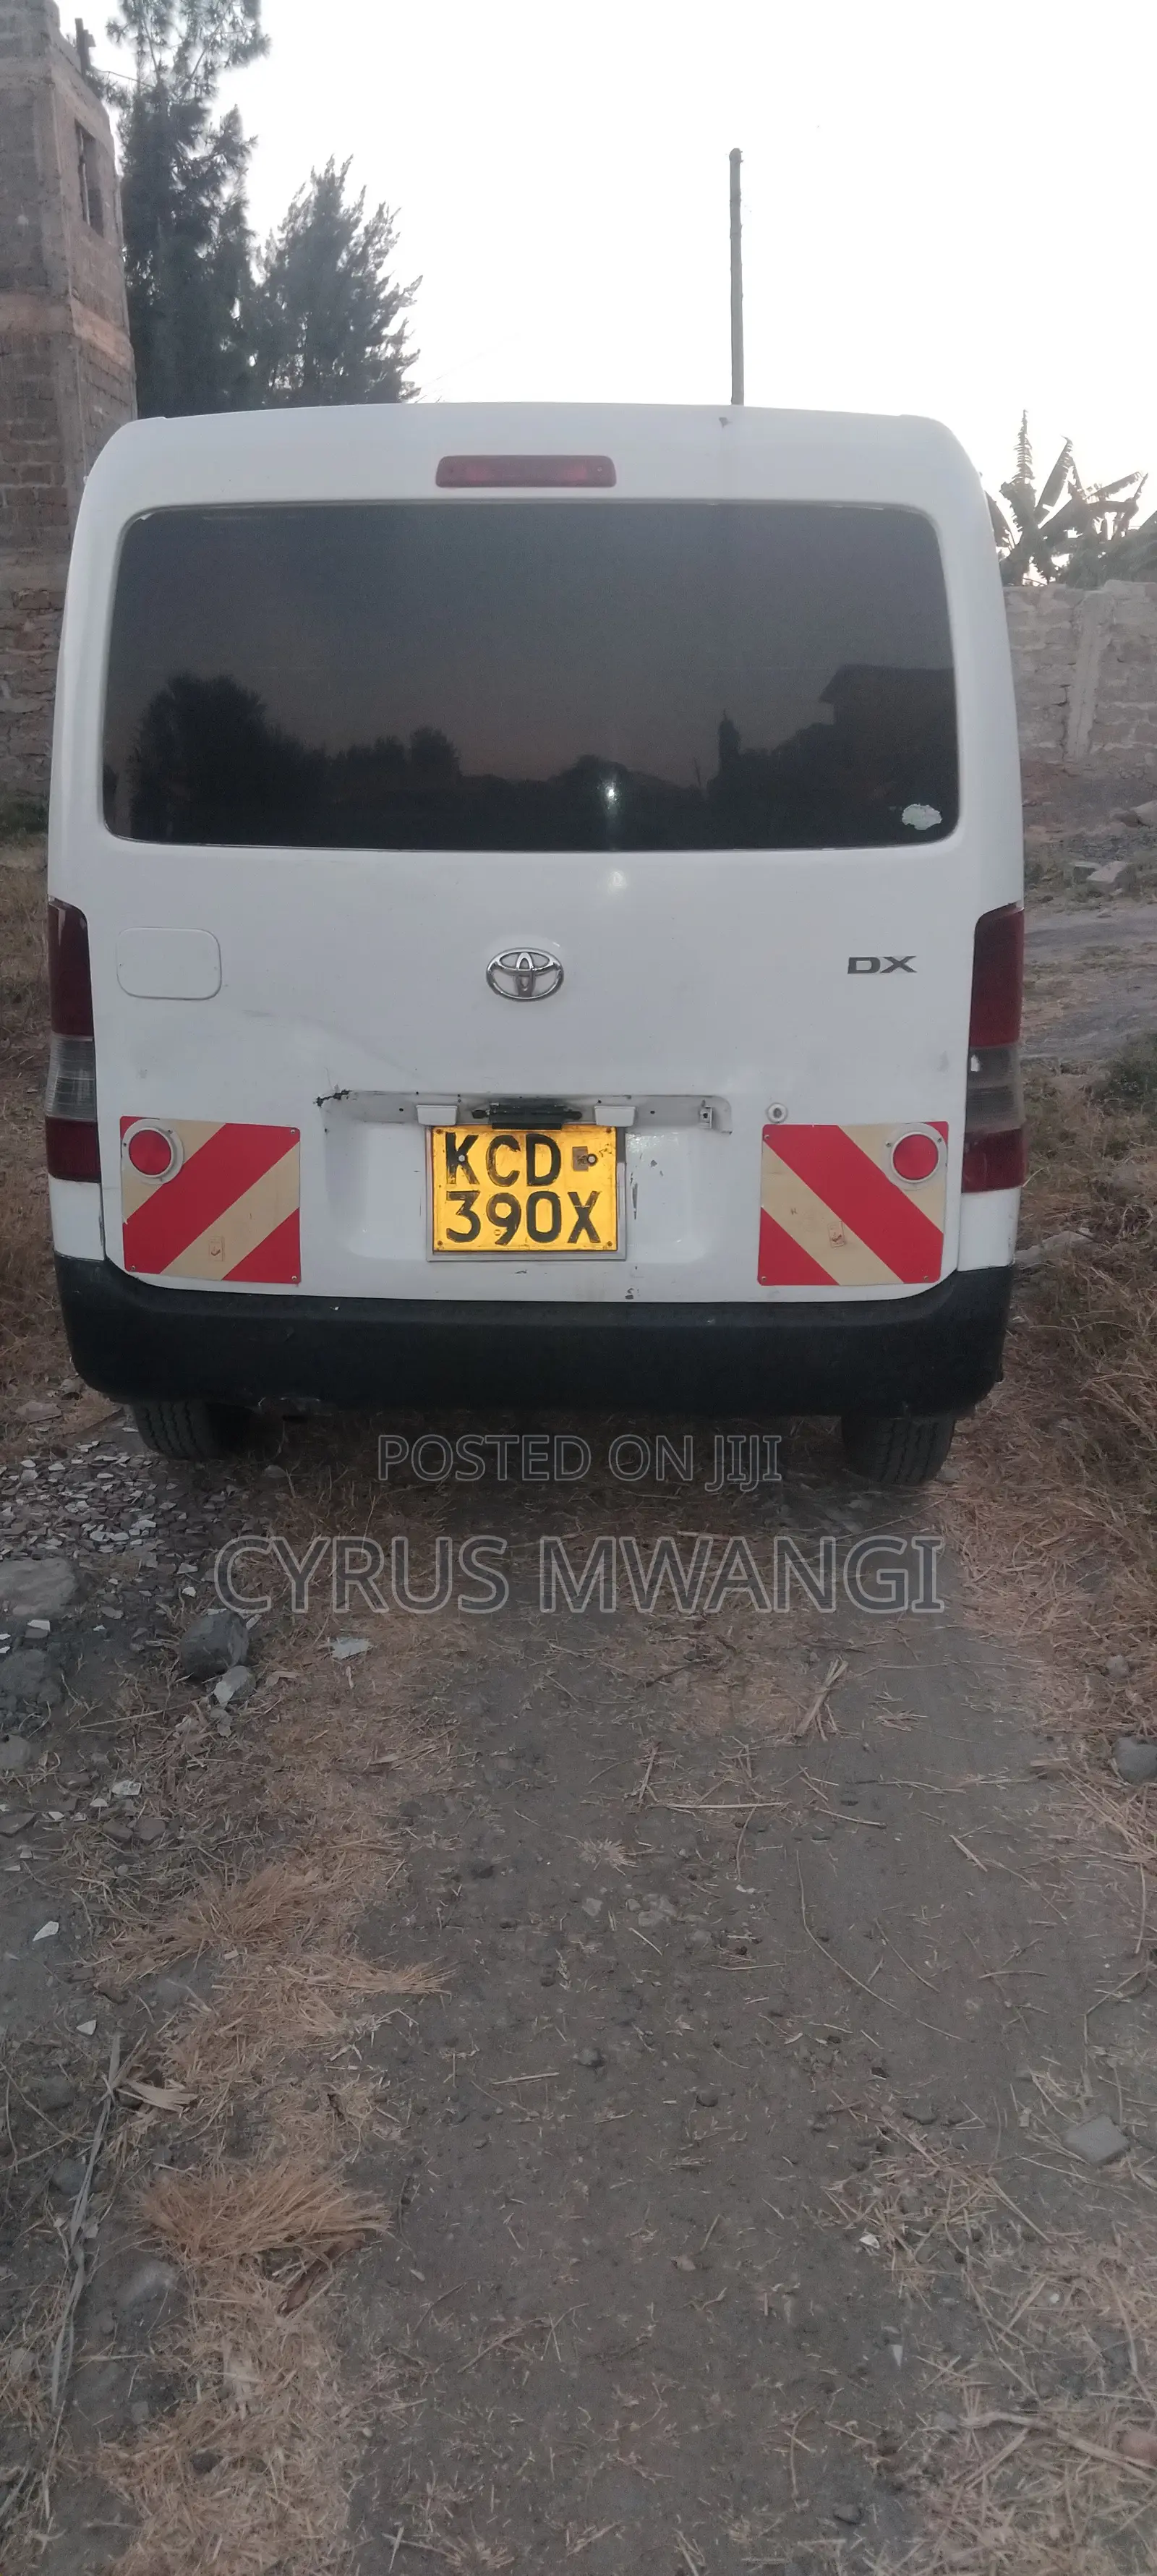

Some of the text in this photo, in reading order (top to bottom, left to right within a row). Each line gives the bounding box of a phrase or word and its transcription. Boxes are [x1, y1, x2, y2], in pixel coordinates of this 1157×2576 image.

[848, 955, 917, 974] DX
[445, 1132, 562, 1187] KCD
[446, 1190, 601, 1245] 390X
